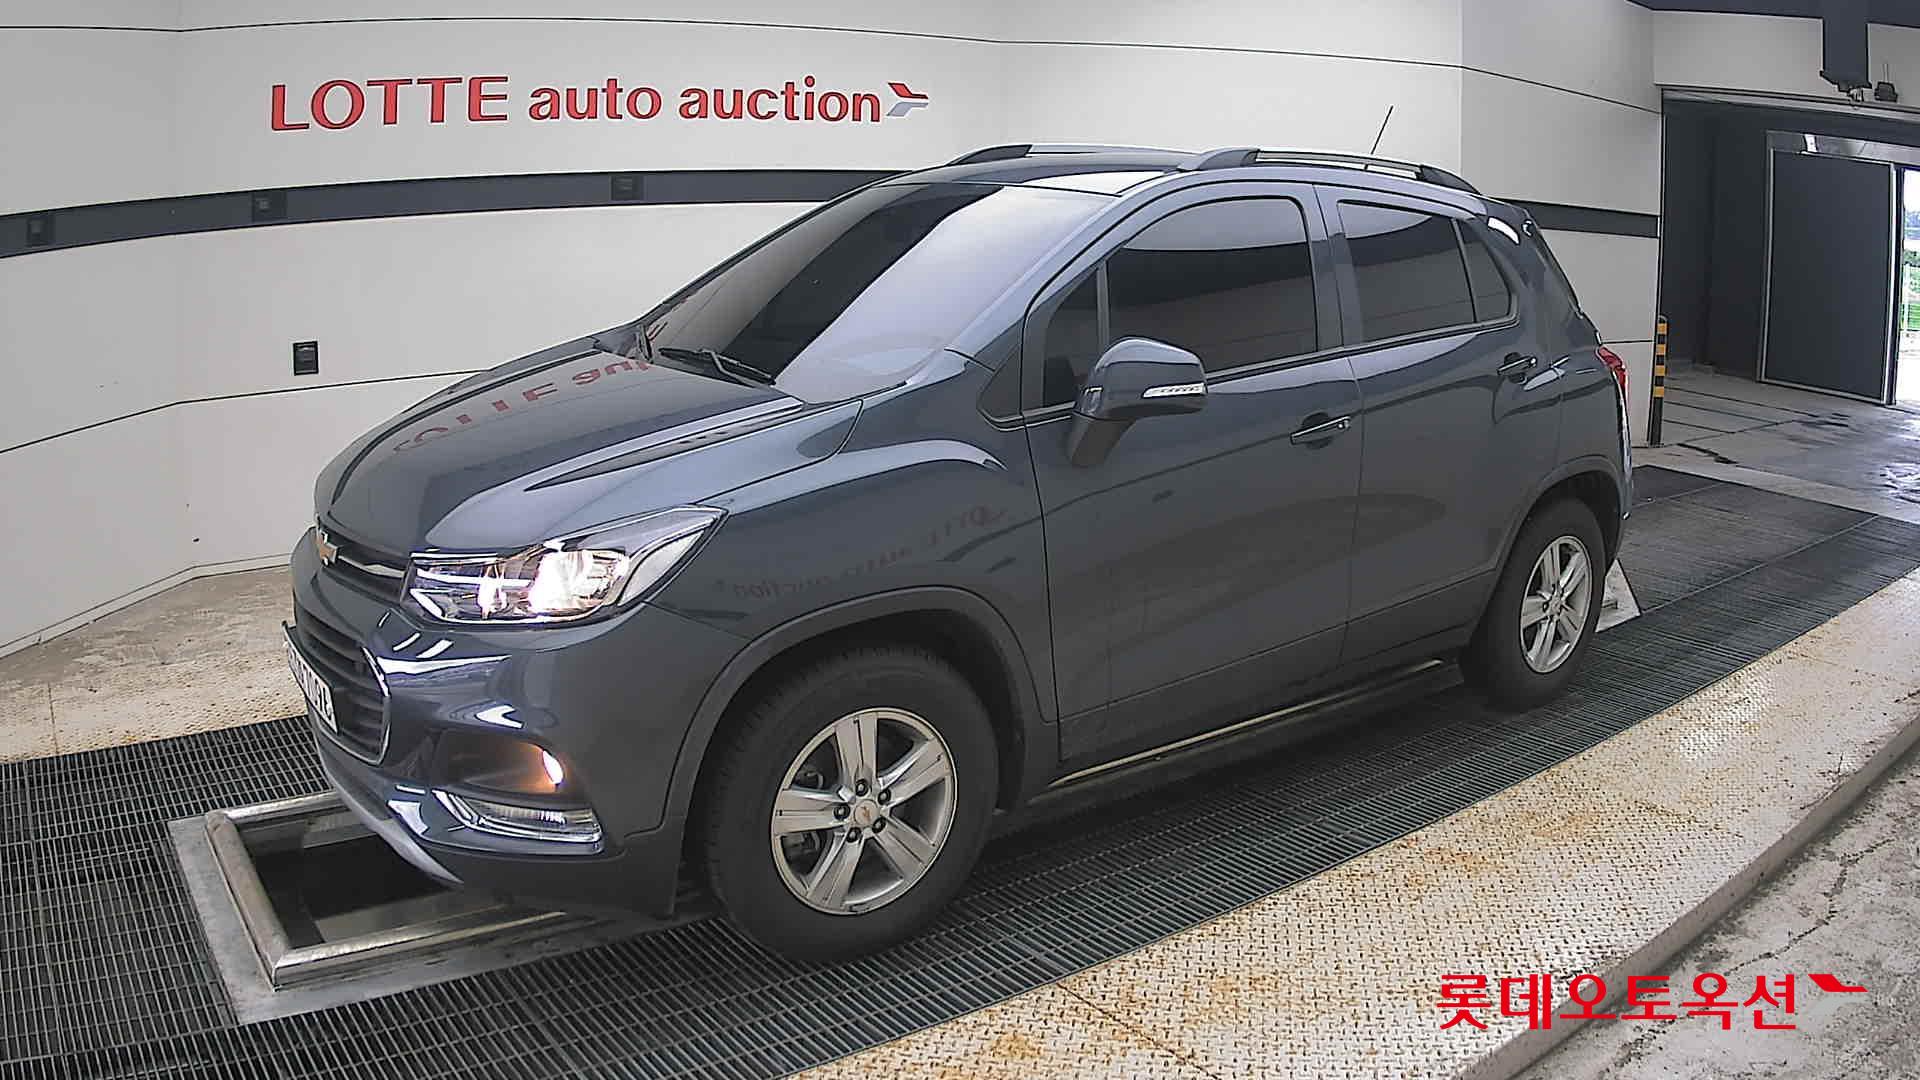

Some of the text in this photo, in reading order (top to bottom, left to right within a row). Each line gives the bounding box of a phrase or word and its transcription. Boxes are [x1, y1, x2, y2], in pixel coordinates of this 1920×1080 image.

[270, 76, 881, 131] LOTTE auto auction
